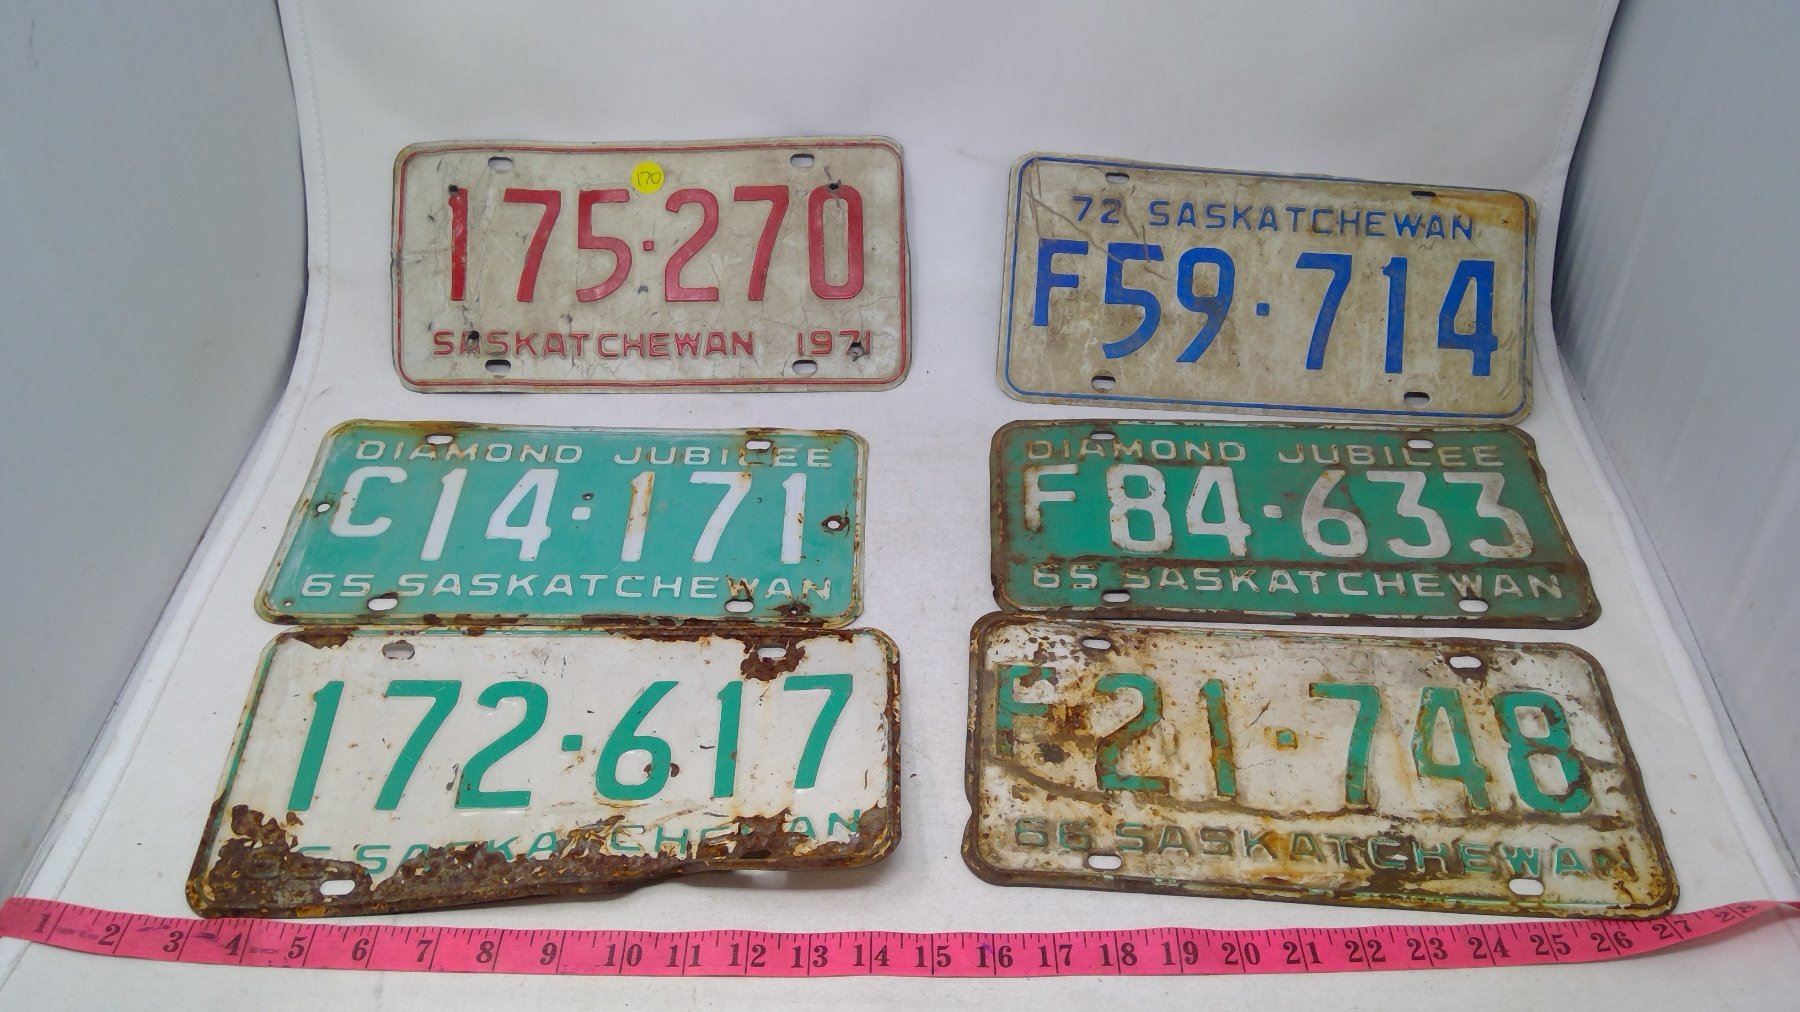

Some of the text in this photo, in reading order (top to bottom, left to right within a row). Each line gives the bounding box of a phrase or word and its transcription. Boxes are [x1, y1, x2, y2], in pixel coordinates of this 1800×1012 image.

[637, 171, 661, 187] 170
[1072, 196, 1473, 241] 72 SASKATCHEWAN
[432, 329, 871, 357] SASKATCHEWAN 1971
[355, 440, 832, 468] DIAMOND JUBILEE
[1027, 439, 1504, 467] DIAMOND JUBILEE
[301, 574, 831, 600] 65 SASKATCHEWAN
[1032, 564, 1563, 599] 65 SASKATCHEWAN
[1015, 817, 1638, 882] 66 SASKATCHEWAN
[33, 913, 52, 933] 1
[98, 924, 121, 946] 2
[163, 931, 183, 952] 3
[287, 936, 307, 959] 5
[352, 938, 370, 961] 6
[416, 940, 433, 962] 7
[475, 940, 495, 963] 8
[539, 942, 557, 965] 9
[603, 943, 642, 967] 10
[665, 944, 702, 967] 11
[727, 943, 767, 967] 12
[790, 945, 828, 968] 13
[853, 944, 890, 967] 14
[913, 945, 951, 968] 15
[976, 945, 1014, 968] 16
[1038, 944, 1073, 967] 17
[1099, 942, 1138, 967] 18
[1160, 940, 1199, 966] 19
[1221, 942, 1261, 965] 20
[1282, 940, 1323, 965] 21
[1344, 939, 1386, 963] 22
[1407, 937, 1448, 961] 23
[1468, 935, 1510, 960] 24
[1529, 933, 1571, 956] 25
[1590, 931, 1633, 953] 26
[1651, 919, 1693, 940] 27
